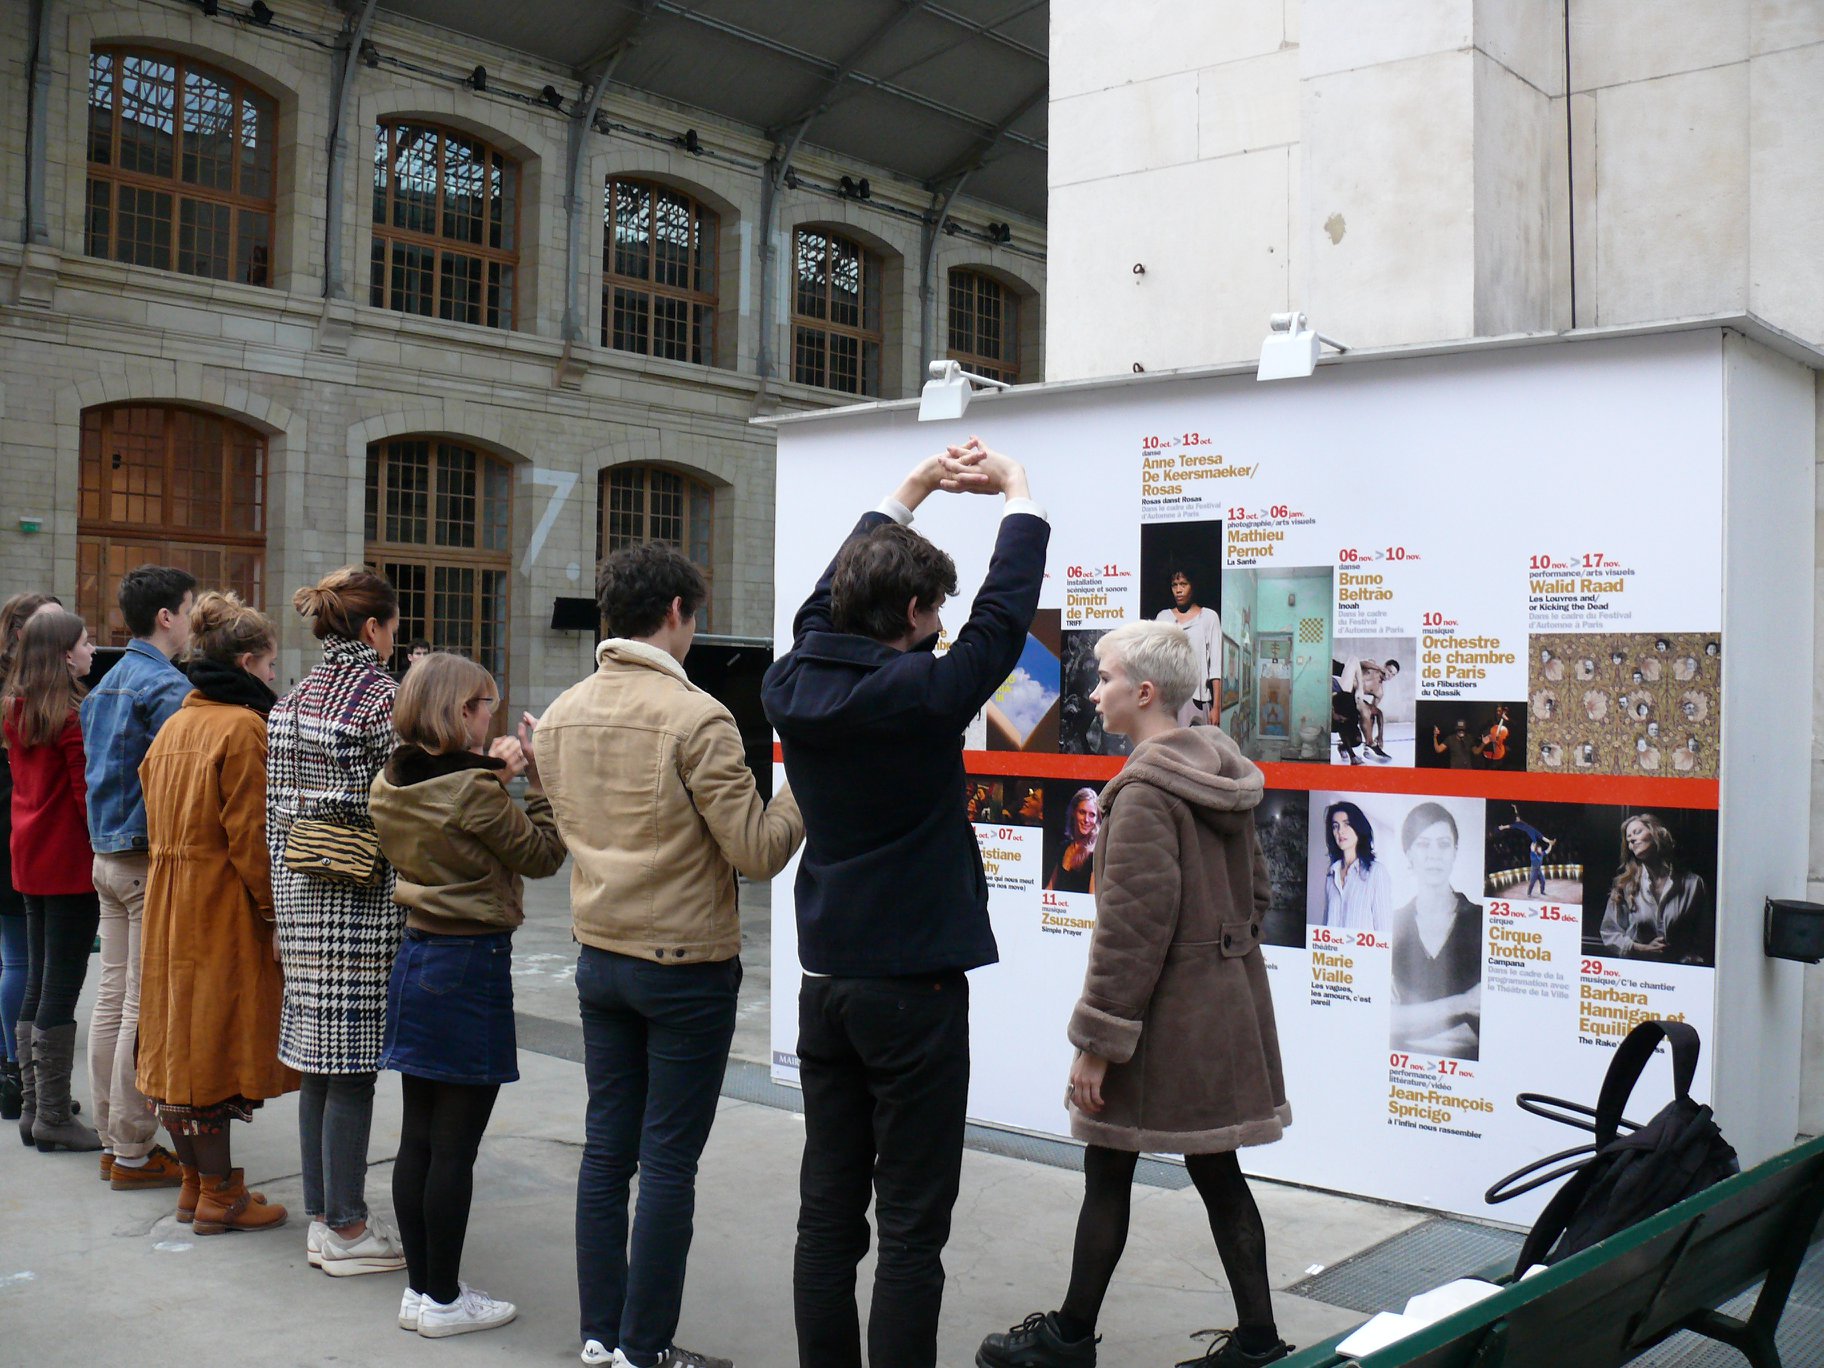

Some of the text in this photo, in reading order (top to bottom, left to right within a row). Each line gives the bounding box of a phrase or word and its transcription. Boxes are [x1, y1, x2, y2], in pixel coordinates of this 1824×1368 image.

[1143, 455, 1222, 469] Anne Teresa
[1143, 471, 1159, 482] De
[1143, 484, 1182, 496] Rosas
[1228, 529, 1283, 542] Mathieu
[1228, 544, 1273, 557] Pernot
[1339, 572, 1383, 585] Bruno
[1530, 578, 1623, 593] Walid Raad
[1339, 586, 1393, 600] Beltrão
[1067, 594, 1107, 606] Dimitri
[1067, 607, 1124, 619] de Perrot
[1599, 611, 1631, 619] Festival
[1423, 635, 1499, 648] Orchestre
[1422, 650, 1515, 663] de chambre
[1422, 665, 1485, 678] de Paris
[1489, 917, 1513, 925] cirque
[1063, 929, 1082, 937] Prayer
[1489, 926, 1542, 945] Cirque
[1489, 942, 1551, 961] Trottola
[1312, 952, 1353, 968] Marie
[1488, 958, 1524, 967] Campana
[1312, 967, 1353, 984] Vialle
[1488, 976, 1547, 987] programmation
[1640, 981, 1675, 991] chantier
[1353, 995, 1371, 1003] c'est
[1551, 990, 1569, 998] Ville
[1581, 984, 1647, 1005] Barbara
[1580, 1001, 1685, 1024] Hannigan et
[1579, 1036, 1593, 1045] The
[1389, 1085, 1494, 1112] Jean-François
[1389, 1101, 1451, 1123] Spricigo
[1419, 1124, 1437, 1132] nous
[1439, 1126, 1481, 1139] rassembler
